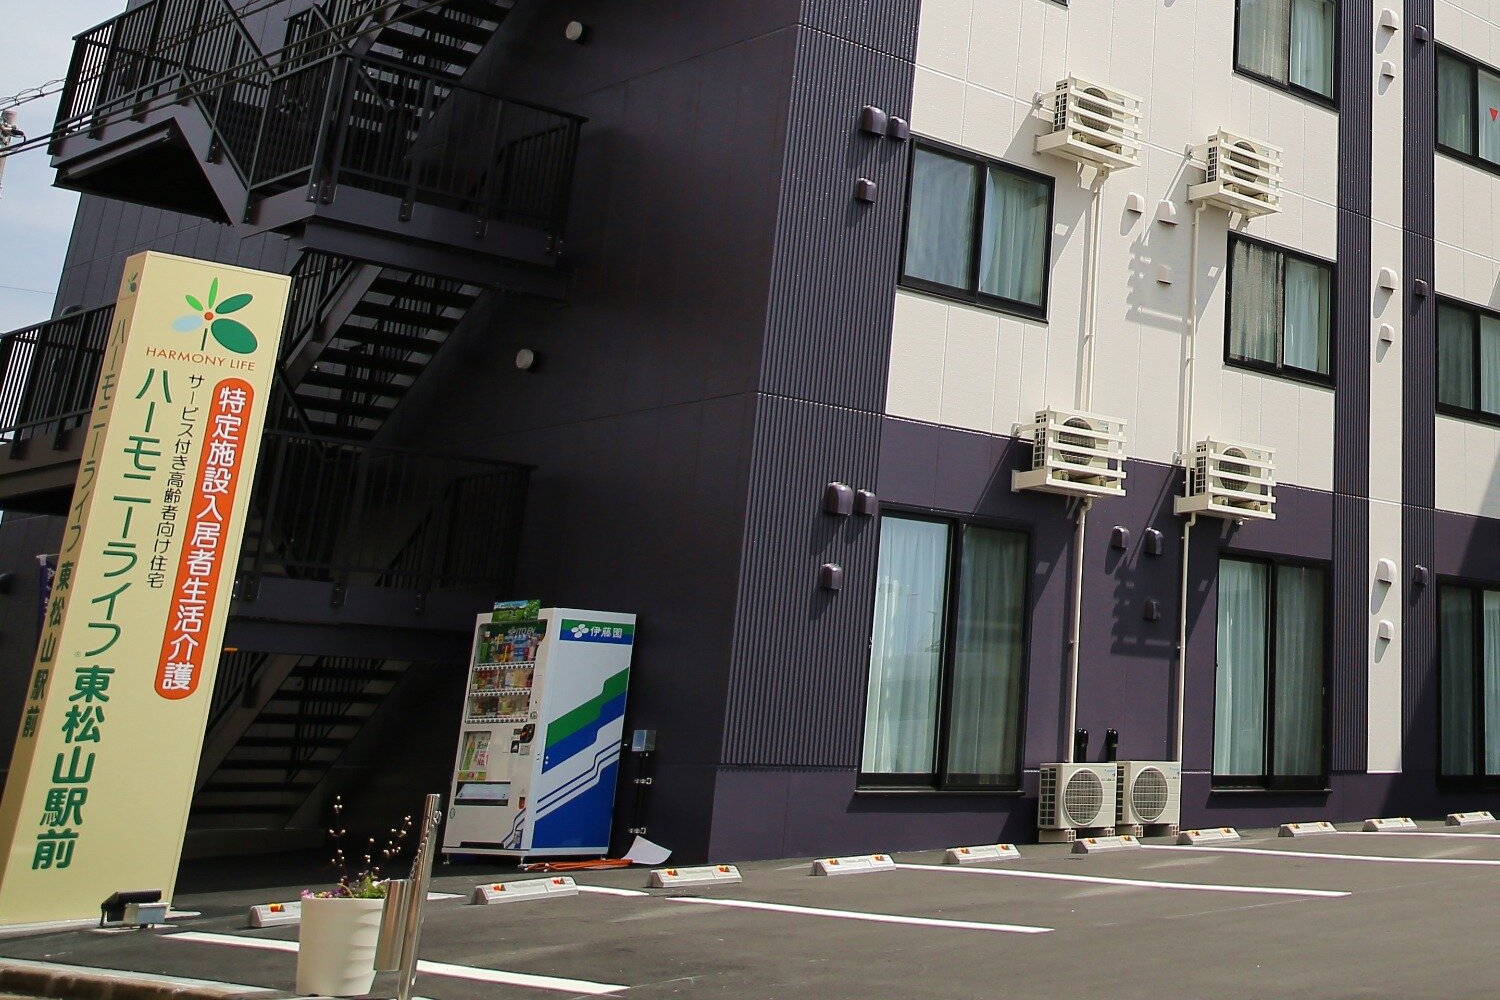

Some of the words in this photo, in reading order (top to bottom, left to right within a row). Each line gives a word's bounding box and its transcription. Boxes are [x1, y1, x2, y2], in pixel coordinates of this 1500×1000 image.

[146, 346, 226, 367] HARMONY
[229, 359, 256, 372] LIFE
[147, 374, 205, 589] サービス付き高齢者向け住宅
[22, 319, 126, 738] ハーモニーライフ東松山駅前
[32, 368, 172, 871] ハーモニーライフ東松山駅前
[162, 387, 246, 691] 特定施設入居者生活介護
[590, 626, 623, 639] 伊藤園
